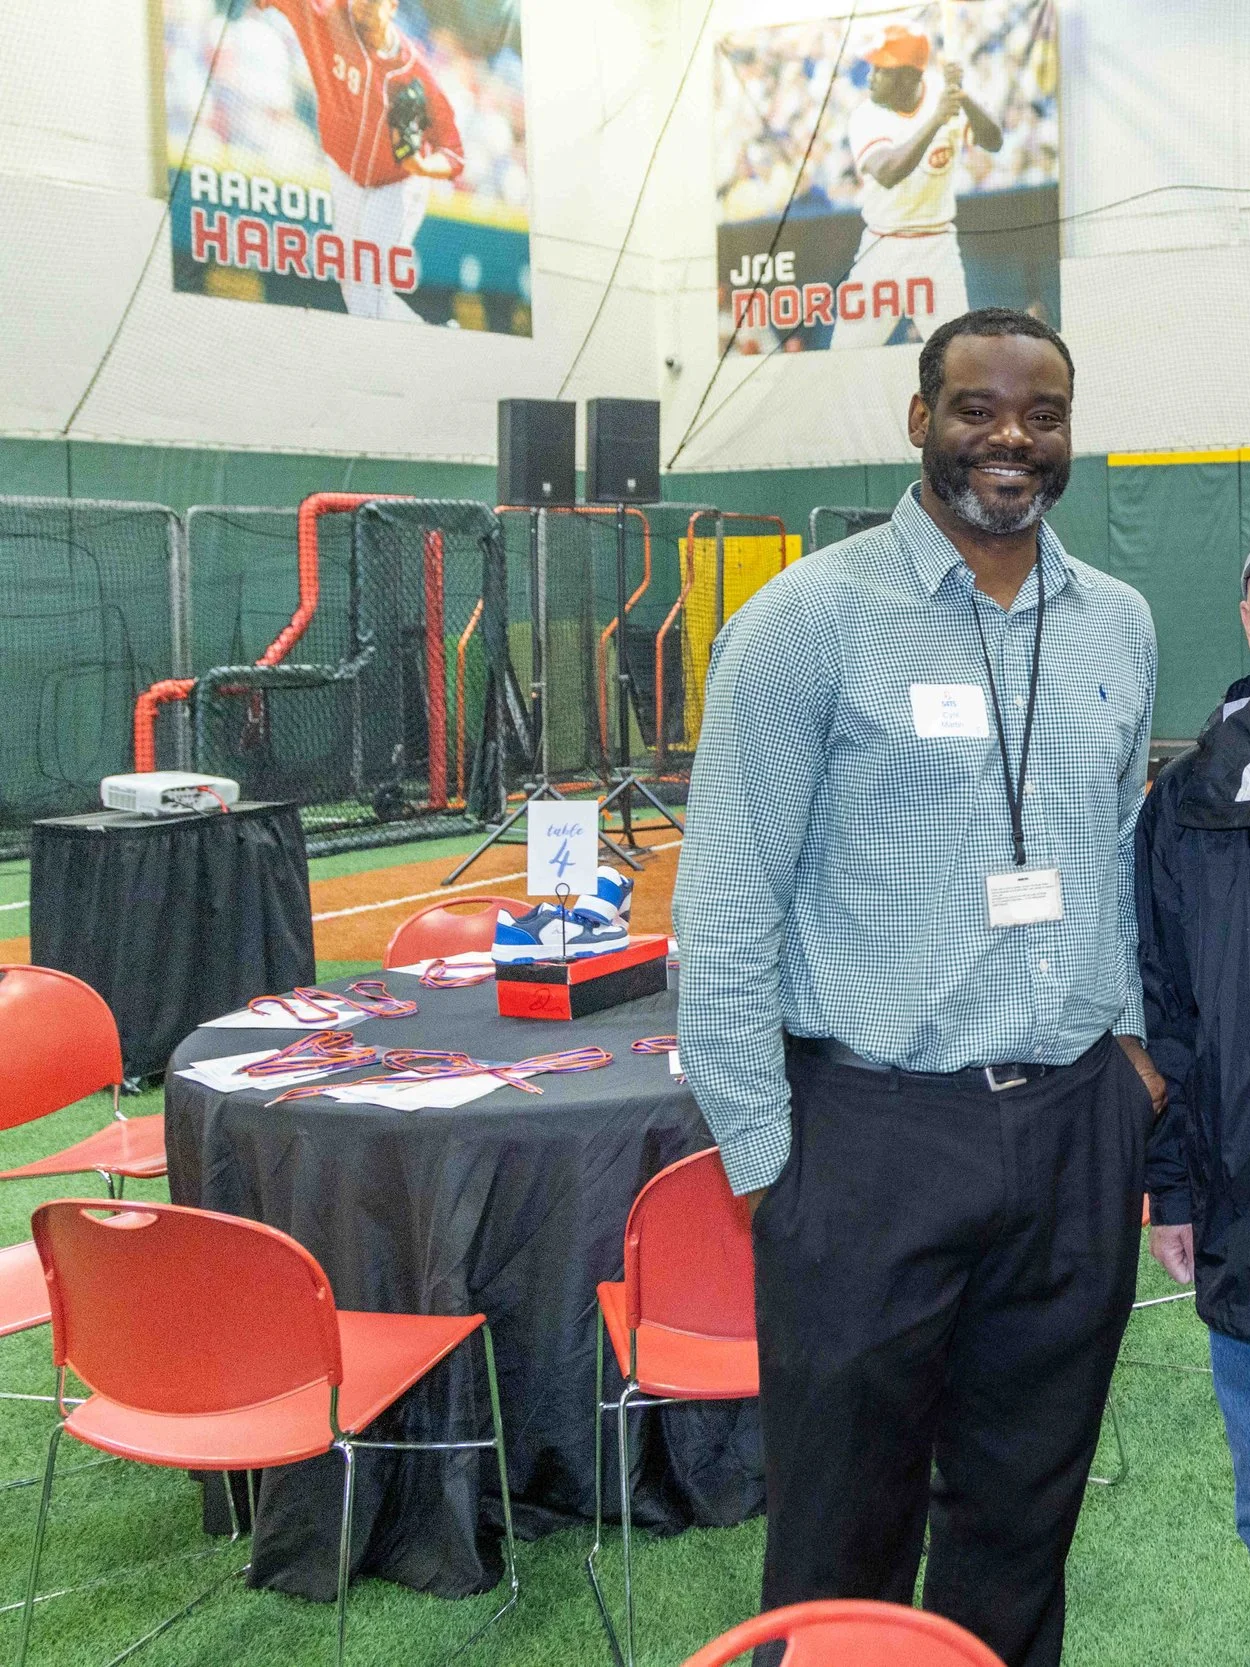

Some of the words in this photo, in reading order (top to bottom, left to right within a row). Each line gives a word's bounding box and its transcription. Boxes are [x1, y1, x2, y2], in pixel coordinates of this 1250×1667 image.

[190, 164, 333, 226] AARON
[190, 206, 418, 293] HARANG
[730, 251, 796, 286] JOE
[731, 277, 937, 330] MORGAN
[547, 823, 582, 837] table
[548, 838, 576, 878] 4
